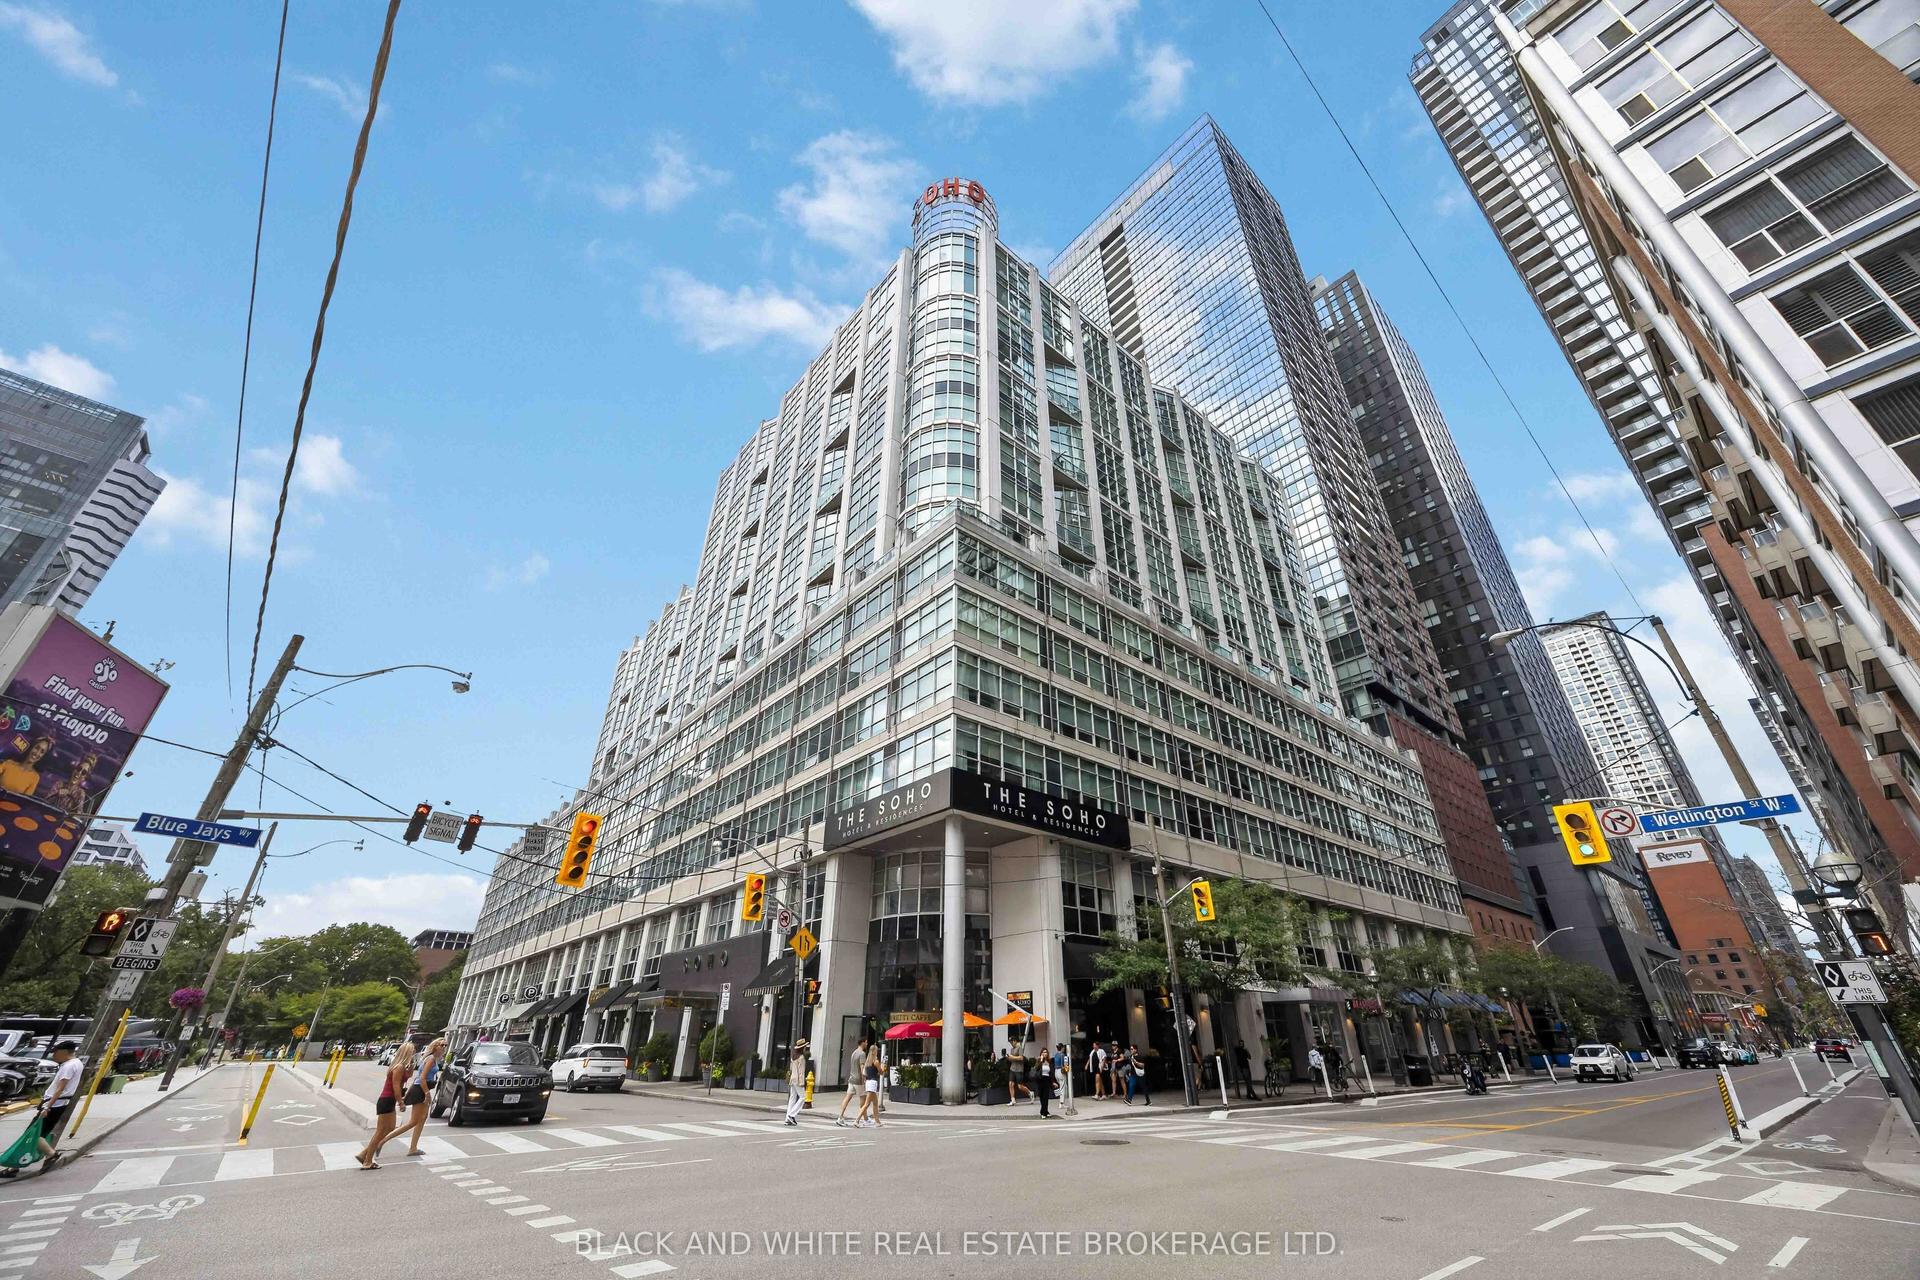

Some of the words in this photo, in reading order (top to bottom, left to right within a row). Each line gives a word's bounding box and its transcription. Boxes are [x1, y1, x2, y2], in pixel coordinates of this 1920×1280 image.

[43, 674, 80, 702] Find
[71, 694, 106, 716] your
[99, 707, 125, 728] fun
[52, 708, 109, 744] PlayOJO
[837, 808, 865, 831] THE
[878, 782, 931, 815] SOHO
[842, 825, 864, 838] HOTEL
[875, 803, 923, 826] RESIDENCES
[983, 782, 1026, 808] THE
[1046, 800, 1106, 829] SOHO
[992, 803, 1025, 818] HOTEL
[1043, 816, 1100, 837] RESIDENCES
[1652, 805, 1745, 827] Wellington
[1749, 800, 1760, 808] St
[1763, 797, 1780, 812] W
[145, 815, 188, 833] Blue
[192, 823, 232, 841] Jays
[239, 828, 252, 838] Wy
[428, 826, 455, 840] SIGNAL
[431, 815, 460, 829] BICYCLE
[1656, 850, 1692, 862] Revery
[116, 959, 156, 969] BEGINS
